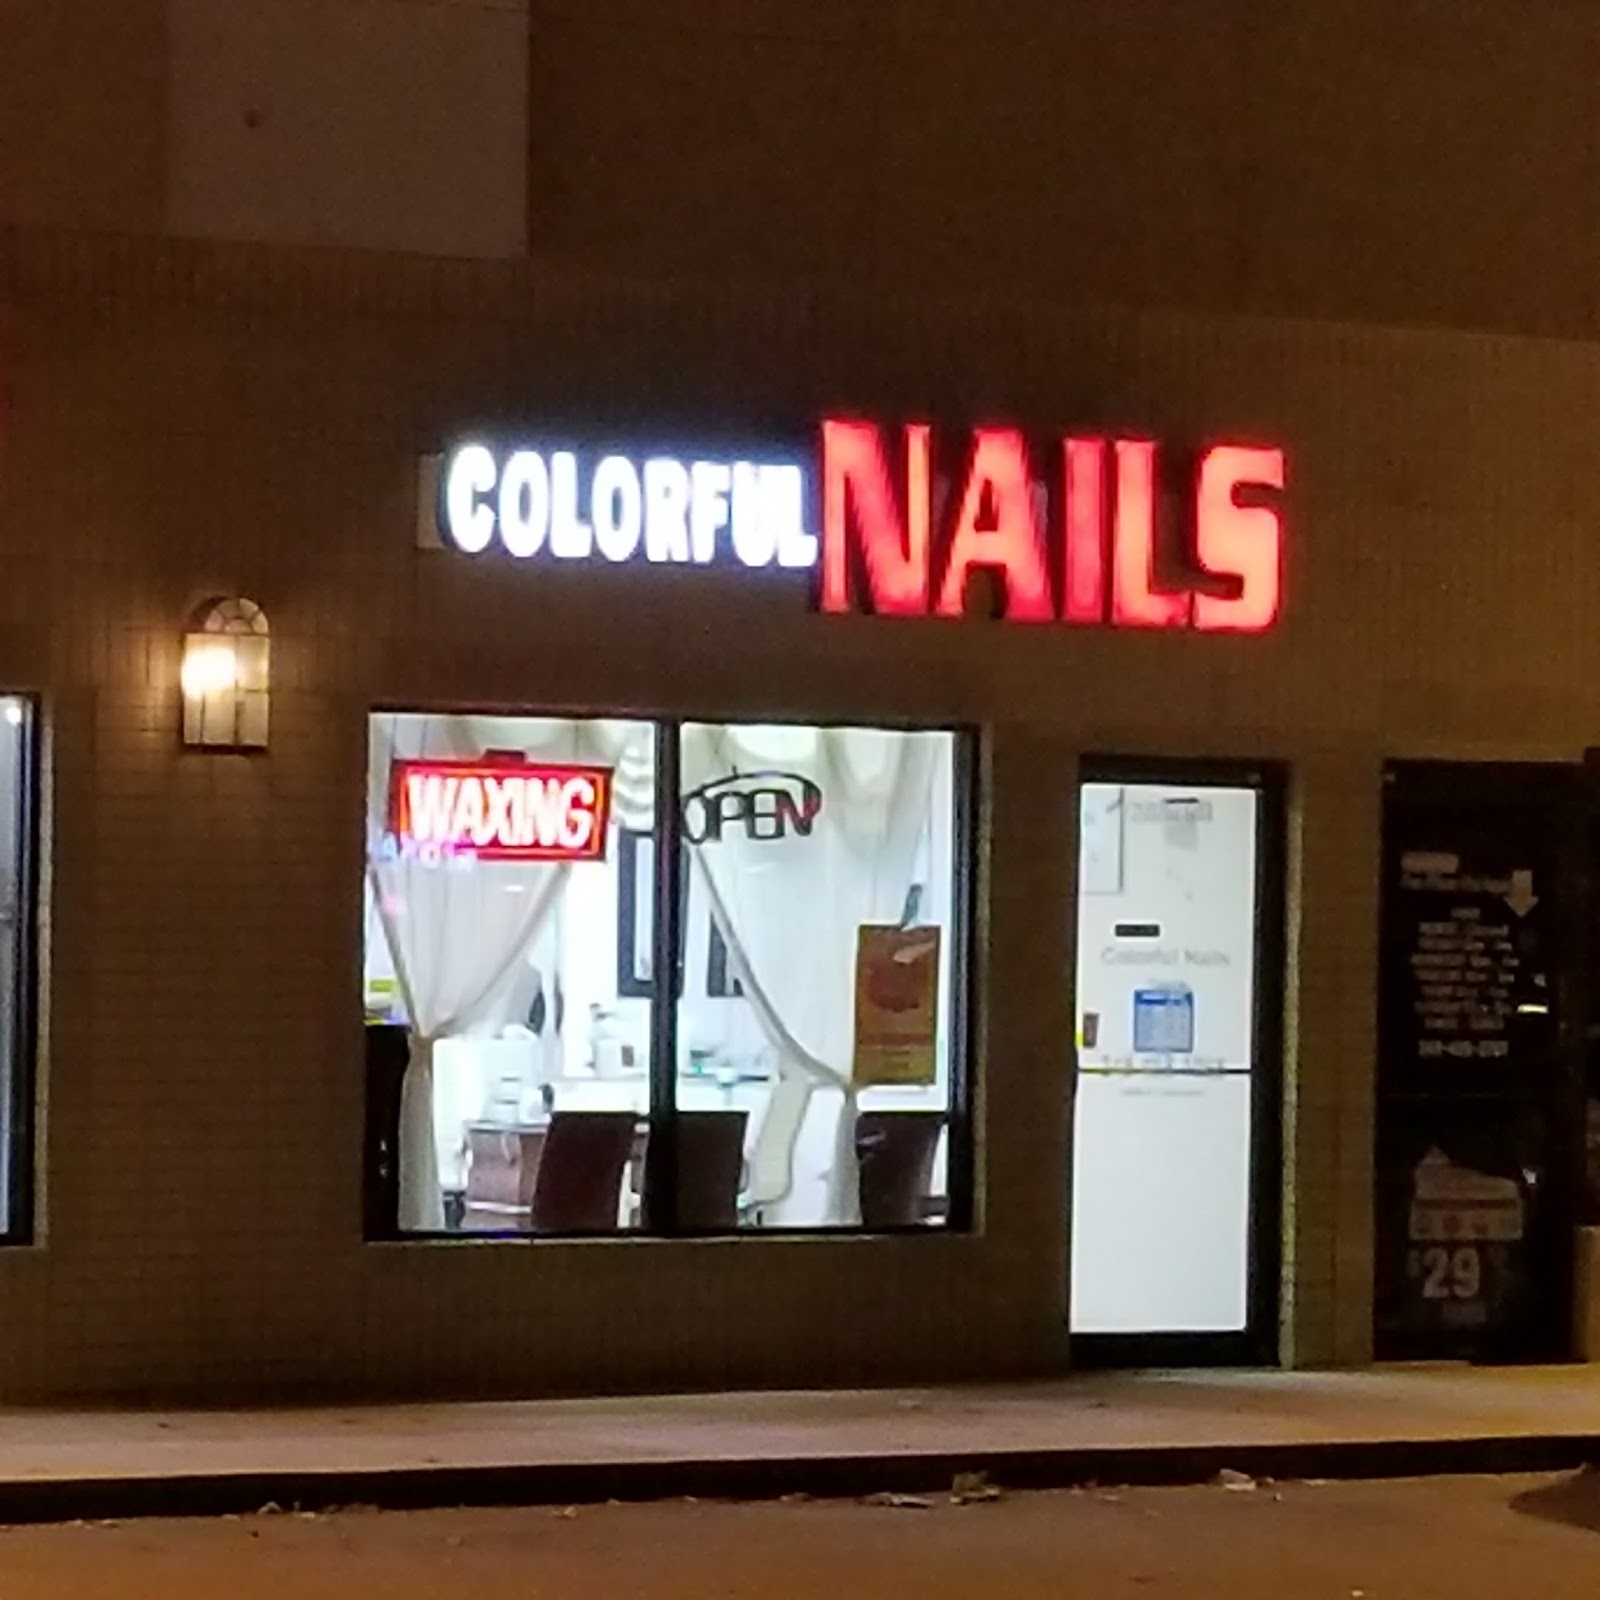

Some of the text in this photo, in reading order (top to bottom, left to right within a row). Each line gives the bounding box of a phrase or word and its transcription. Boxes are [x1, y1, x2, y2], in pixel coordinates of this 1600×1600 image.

[446, 419, 1286, 631] COLORFUL NAILS
[407, 774, 597, 848] WAXING
[684, 786, 819, 844] OPEN
